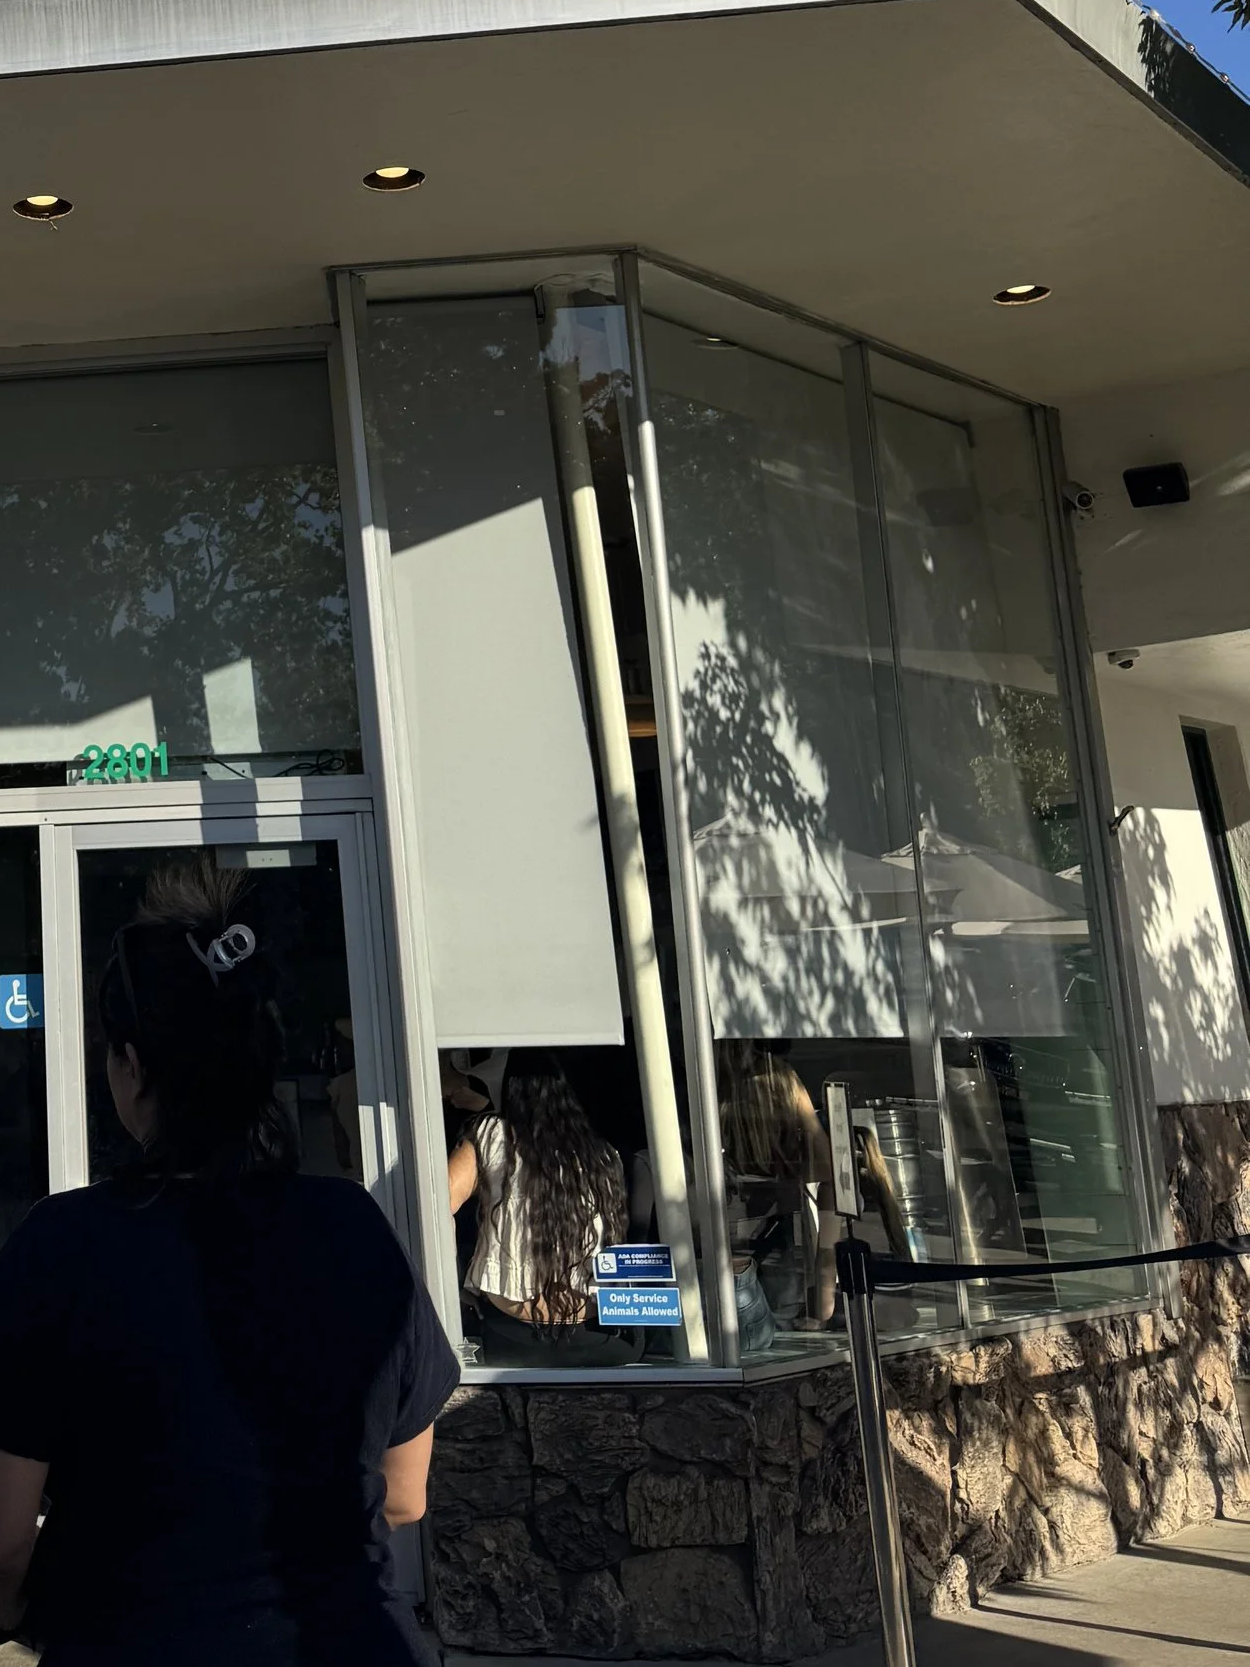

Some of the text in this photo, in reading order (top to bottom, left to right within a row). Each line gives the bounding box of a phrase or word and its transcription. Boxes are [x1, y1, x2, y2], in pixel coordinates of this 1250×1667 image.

[83, 741, 169, 780] 2801
[610, 1293, 668, 1304] Only Service
[602, 1306, 678, 1316] Animals Allowed
